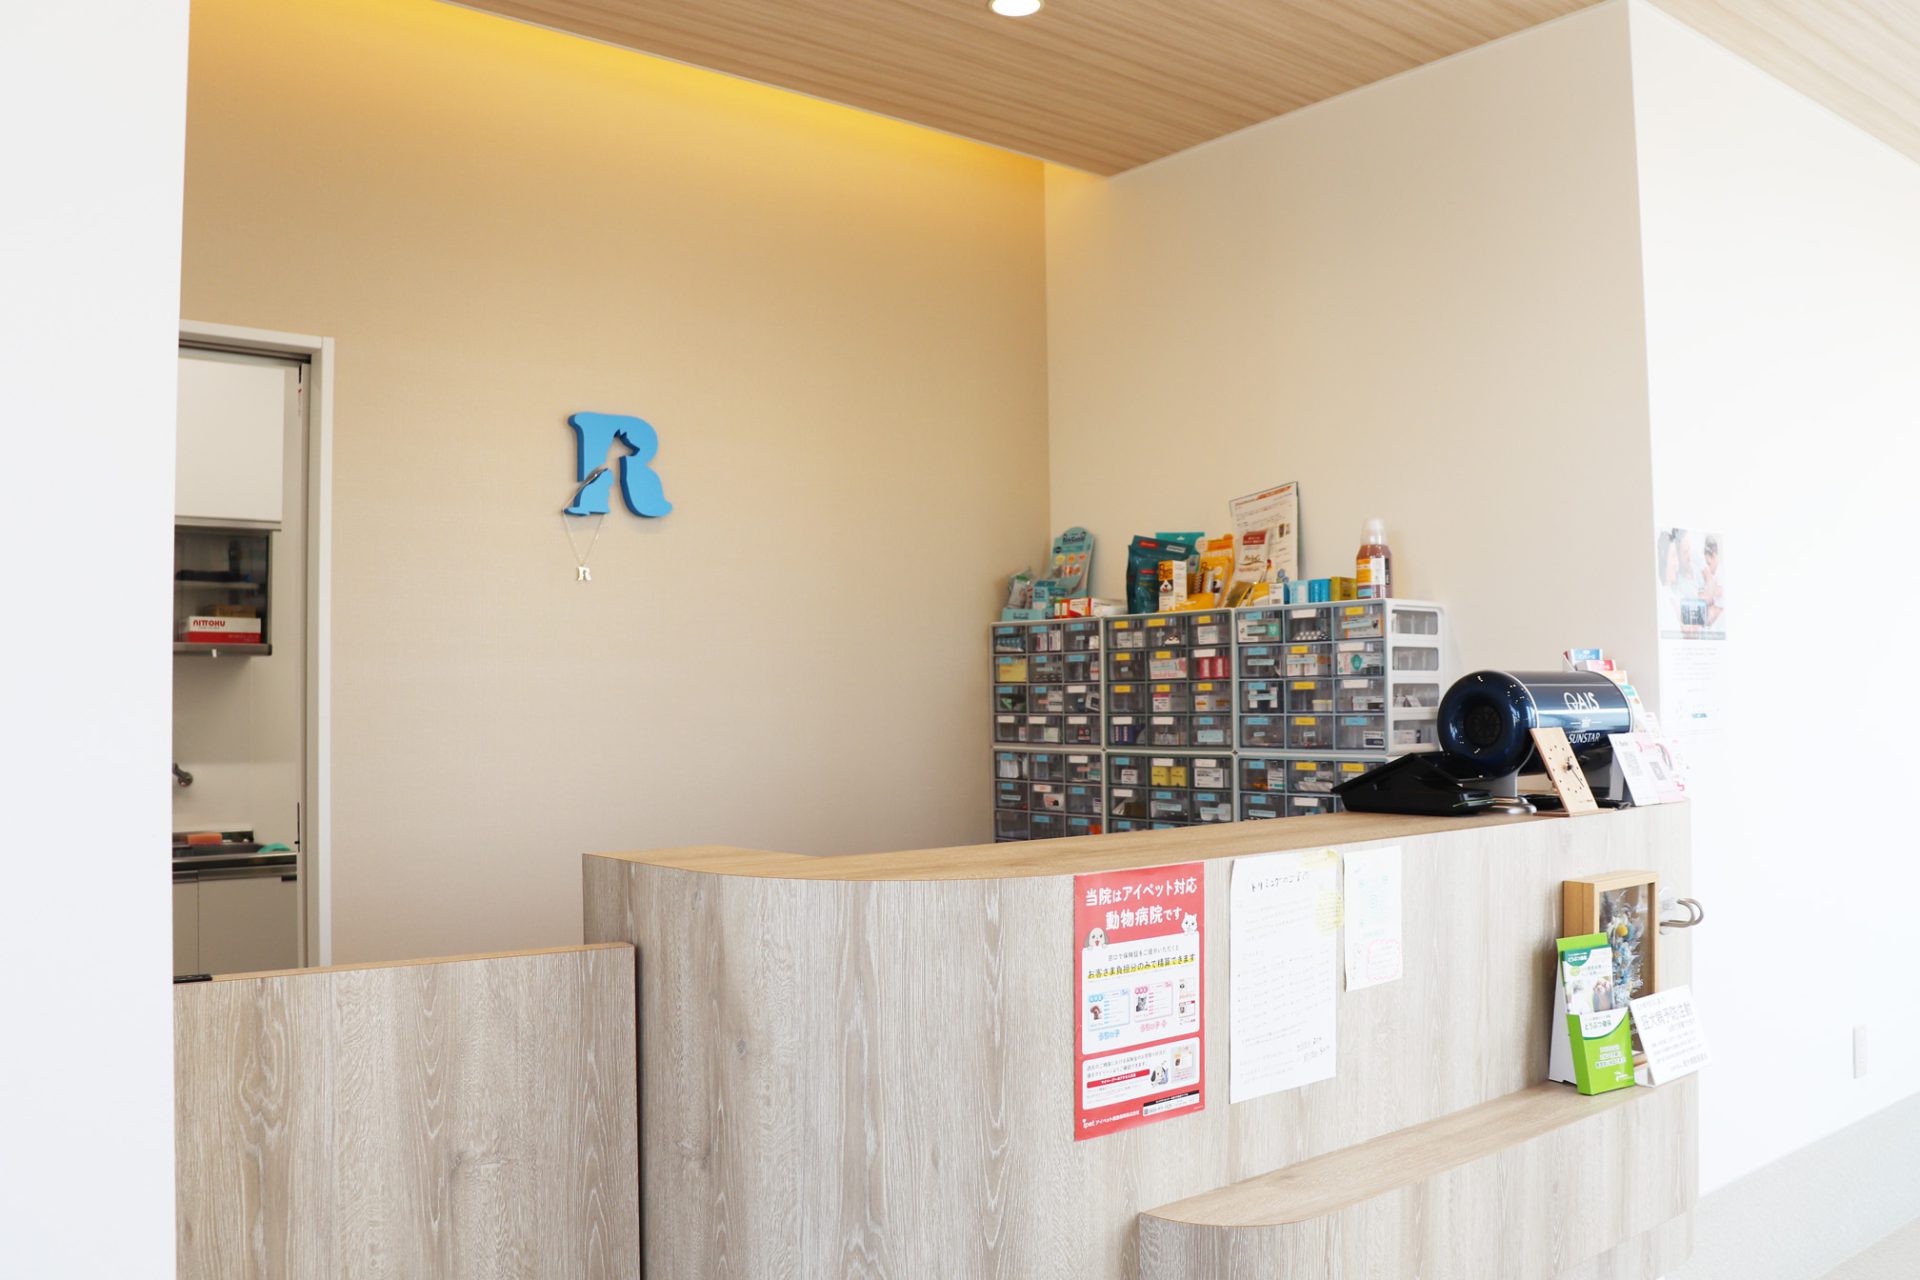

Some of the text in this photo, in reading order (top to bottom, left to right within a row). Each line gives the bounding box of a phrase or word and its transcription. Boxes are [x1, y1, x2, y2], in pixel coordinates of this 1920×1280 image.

[562, 411, 673, 518] R
[1568, 732, 1600, 744] SUNSTAR
[1085, 877, 1198, 906] 当院はアイペット対応
[1105, 905, 1182, 930] 動物病院です
